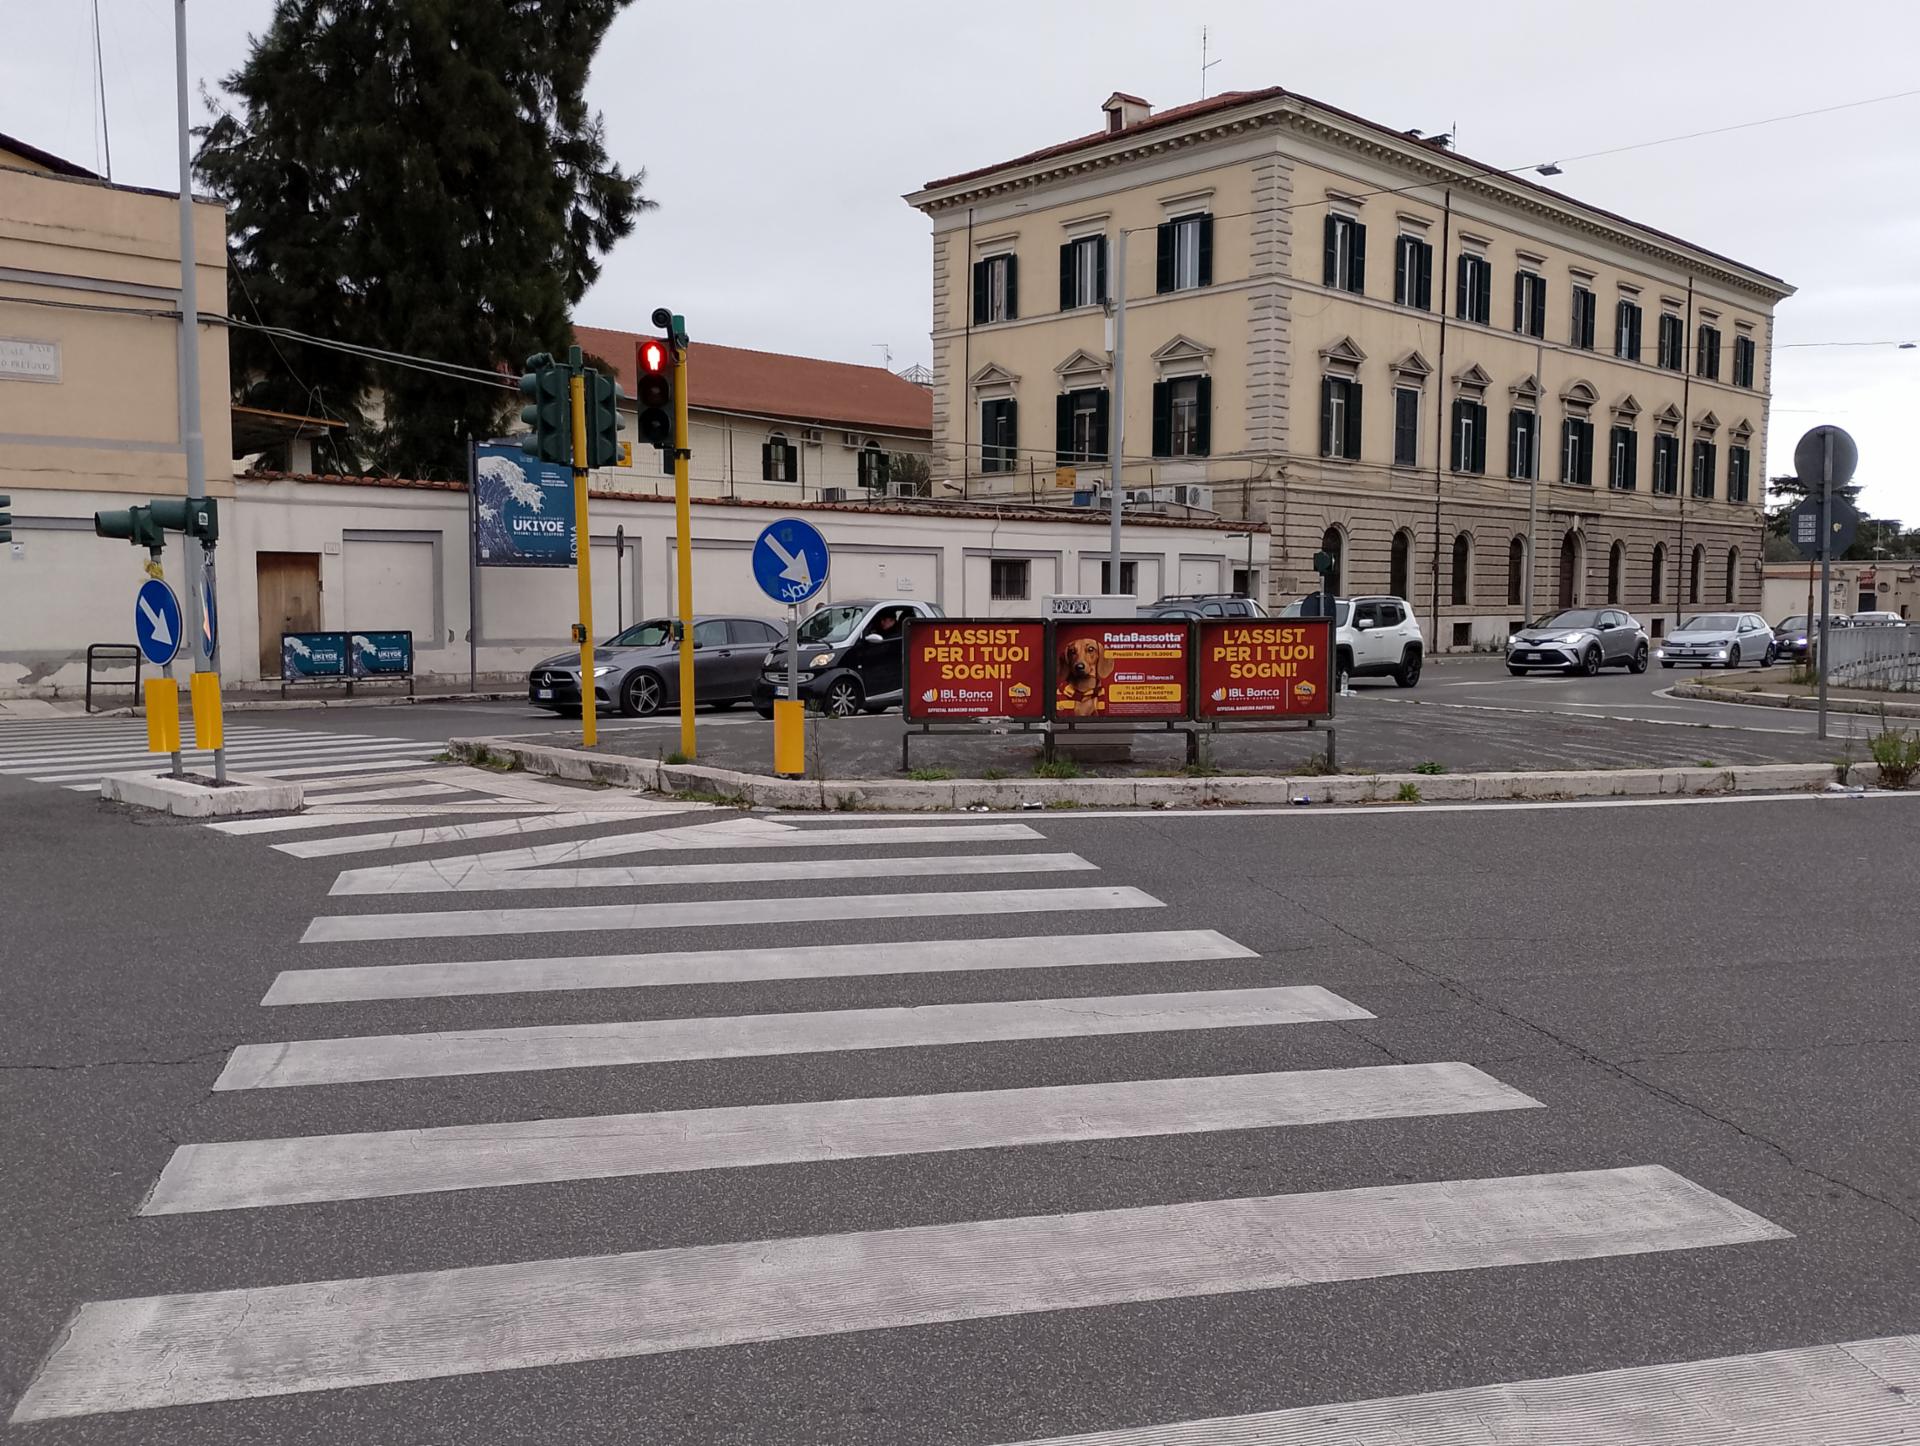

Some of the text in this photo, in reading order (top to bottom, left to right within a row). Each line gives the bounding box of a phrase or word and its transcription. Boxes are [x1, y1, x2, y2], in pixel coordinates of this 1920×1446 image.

[513, 519, 565, 532] UKIYOE
[934, 629, 1019, 645] L'ASSIST
[1224, 628, 1305, 644] L'ASSIST
[924, 646, 1029, 662] PER I TUOI
[1213, 645, 1314, 662] PER I TUOI
[941, 664, 1012, 679] SOGNI!
[1230, 662, 1297, 678] SOGNI!
[940, 689, 993, 699] IBL Banca
[1229, 687, 1280, 697] IBL Banca
